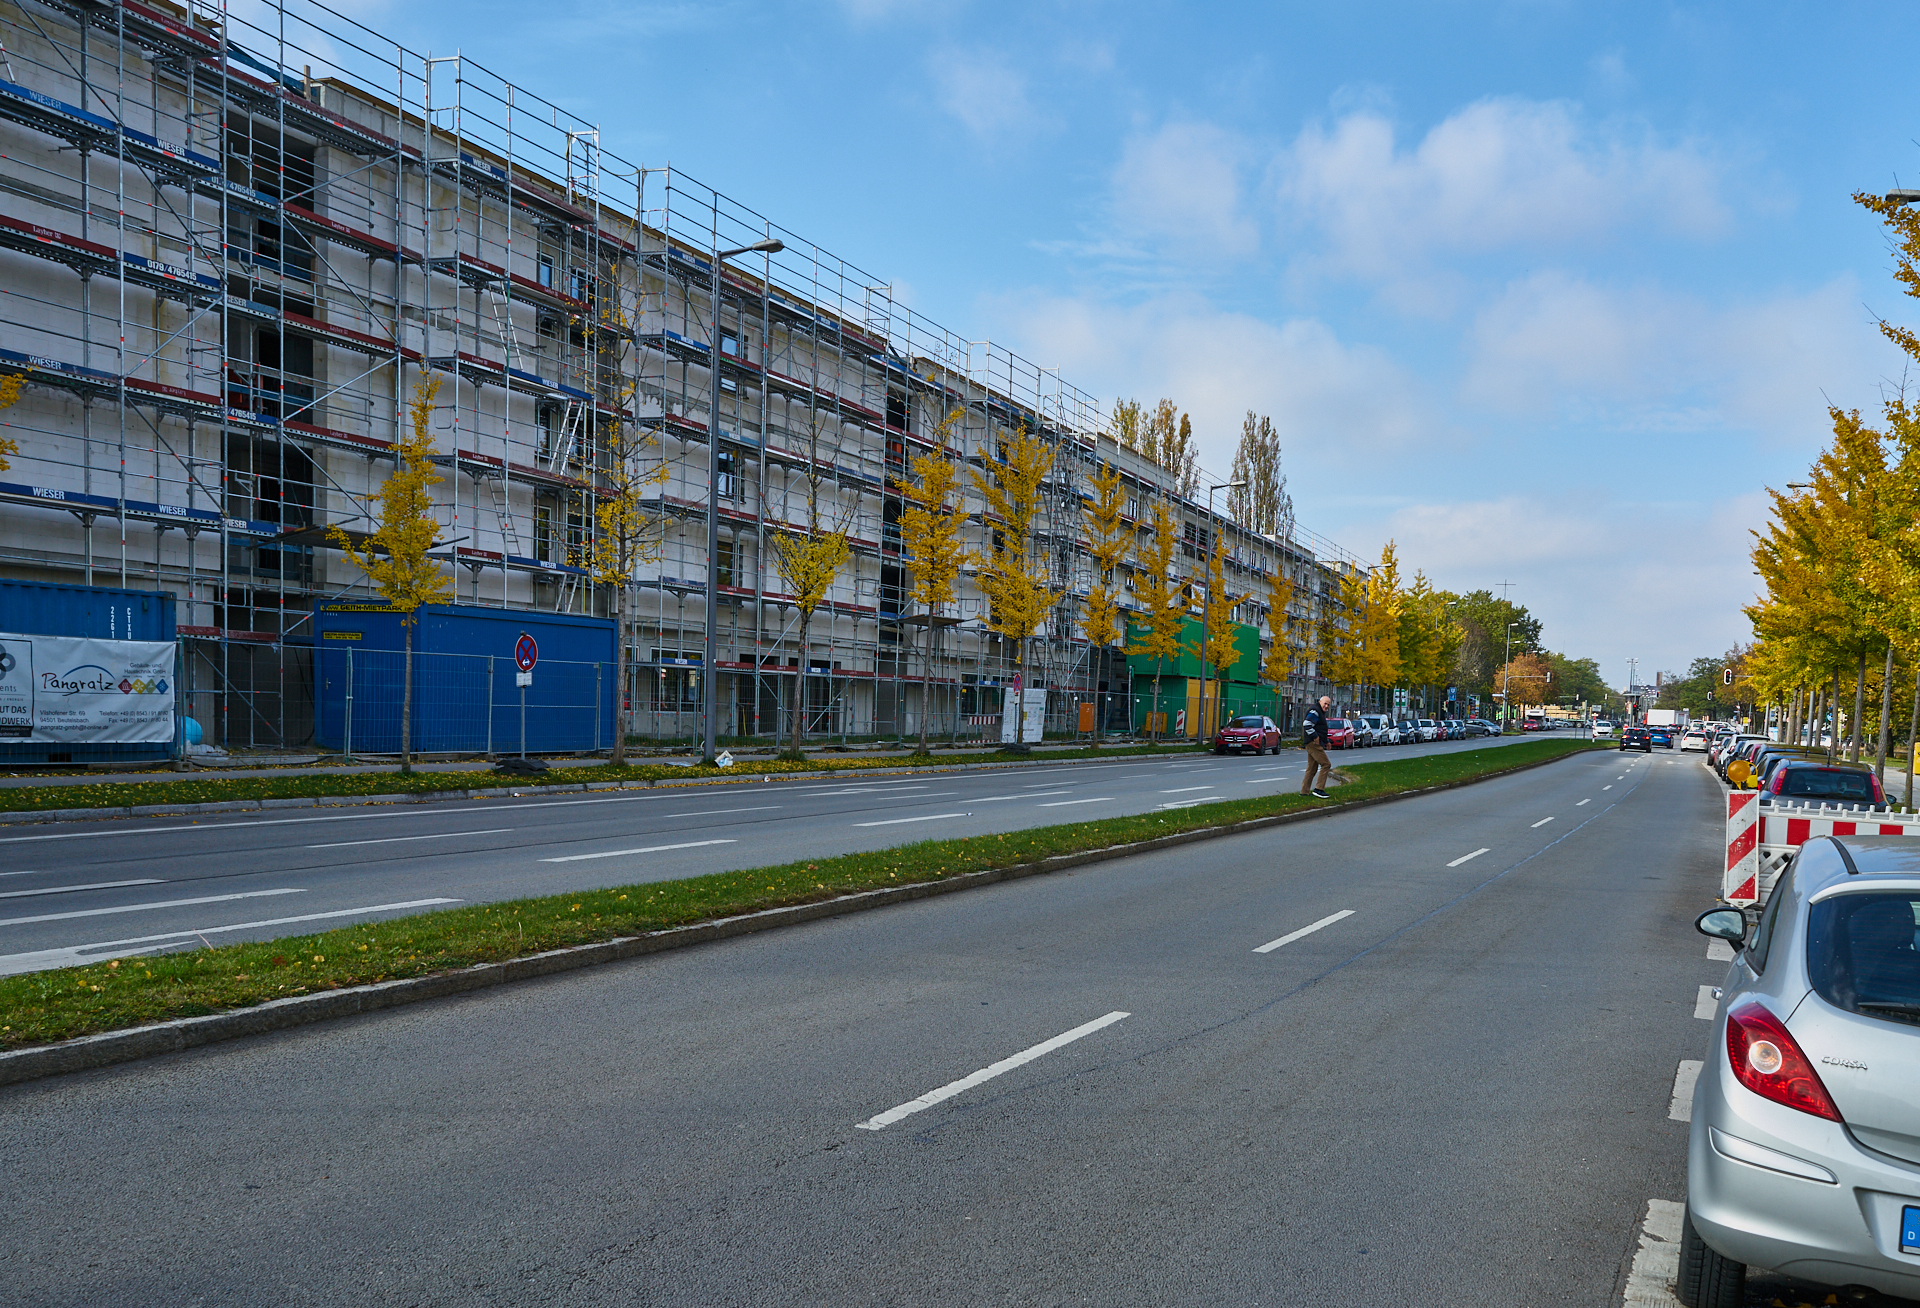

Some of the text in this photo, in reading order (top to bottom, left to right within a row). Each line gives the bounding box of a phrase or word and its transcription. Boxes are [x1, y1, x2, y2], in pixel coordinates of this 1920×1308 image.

[28, 90, 62, 109] WIESER
[157, 139, 185, 157] WIESER
[472, 156, 491, 173] WIESER
[33, 225, 53, 237] Layher
[147, 259, 197, 281] 0179/4765415
[28, 355, 62, 370] WIESER
[542, 378, 559, 390] WIESER
[32, 486, 65, 500] WIESER
[158, 505, 187, 516] WIESER
[41, 672, 117, 696] Pangratz
[11, 706, 27, 714] DAS
[1821, 1056, 1868, 1070] CORSA
[1907, 1230, 1916, 1241] D
